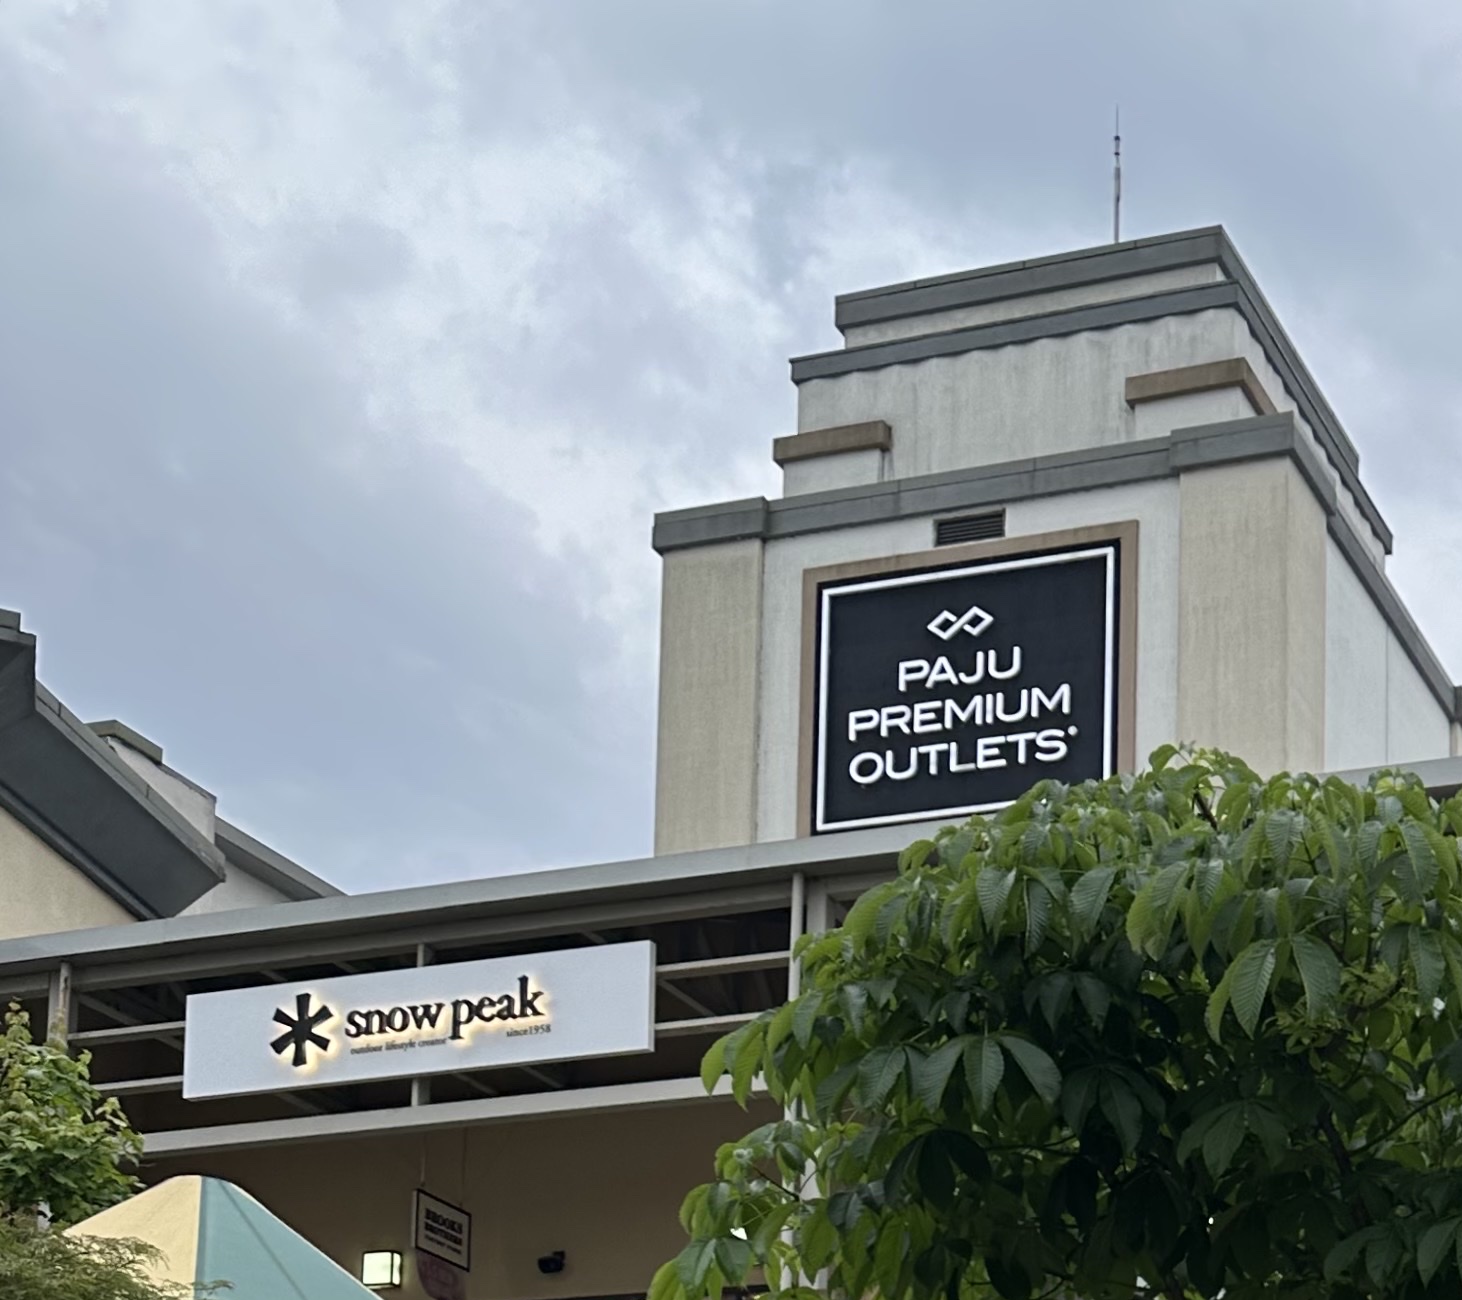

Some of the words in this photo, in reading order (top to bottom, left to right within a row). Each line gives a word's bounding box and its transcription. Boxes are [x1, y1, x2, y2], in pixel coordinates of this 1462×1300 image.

[898, 646, 1020, 691] PAJU
[848, 683, 1071, 741] PREMIUM
[345, 1003, 445, 1038] snow
[450, 975, 545, 1040] peak
